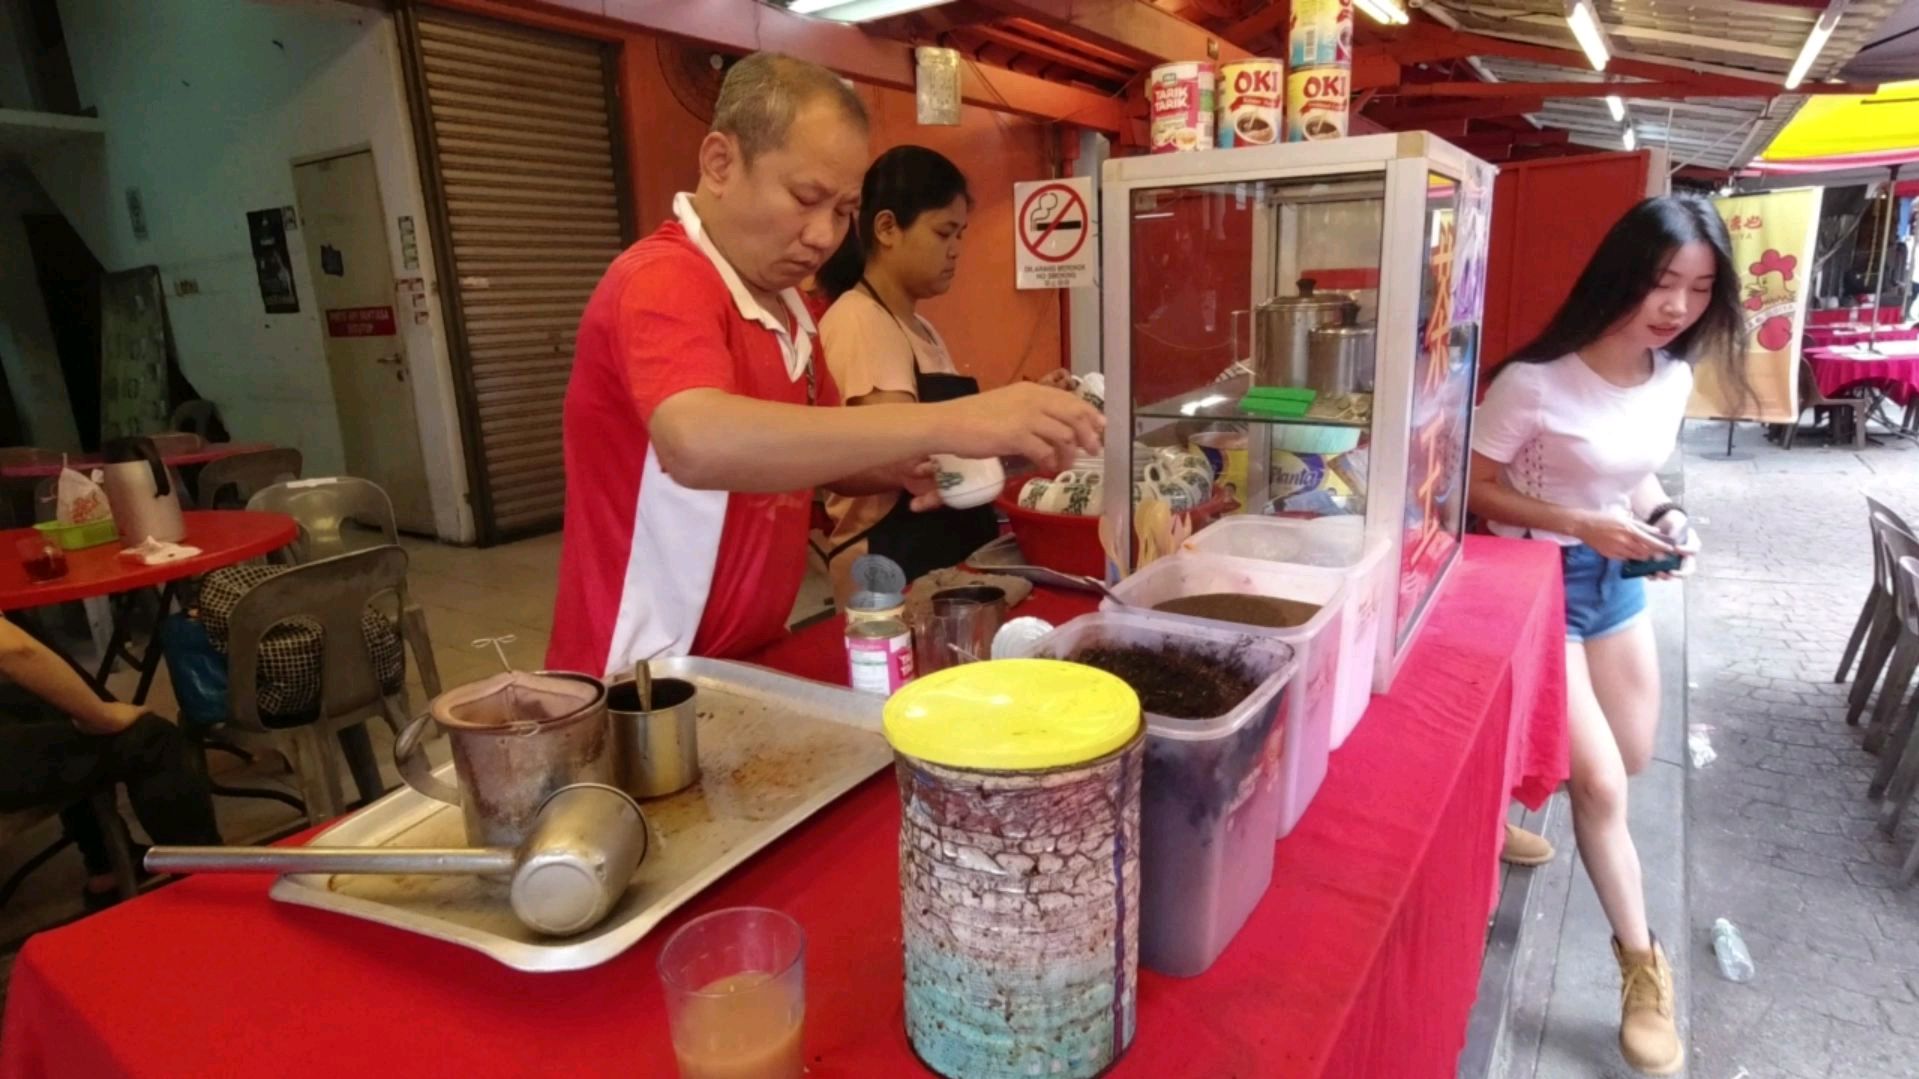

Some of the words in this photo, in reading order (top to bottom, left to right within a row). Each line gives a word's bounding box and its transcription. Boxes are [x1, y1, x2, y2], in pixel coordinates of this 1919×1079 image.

[1234, 70, 1278, 94] OKI
[1303, 76, 1346, 98] OKI
[1155, 86, 1188, 98] TARIK
[1155, 98, 1189, 112] TARIK
